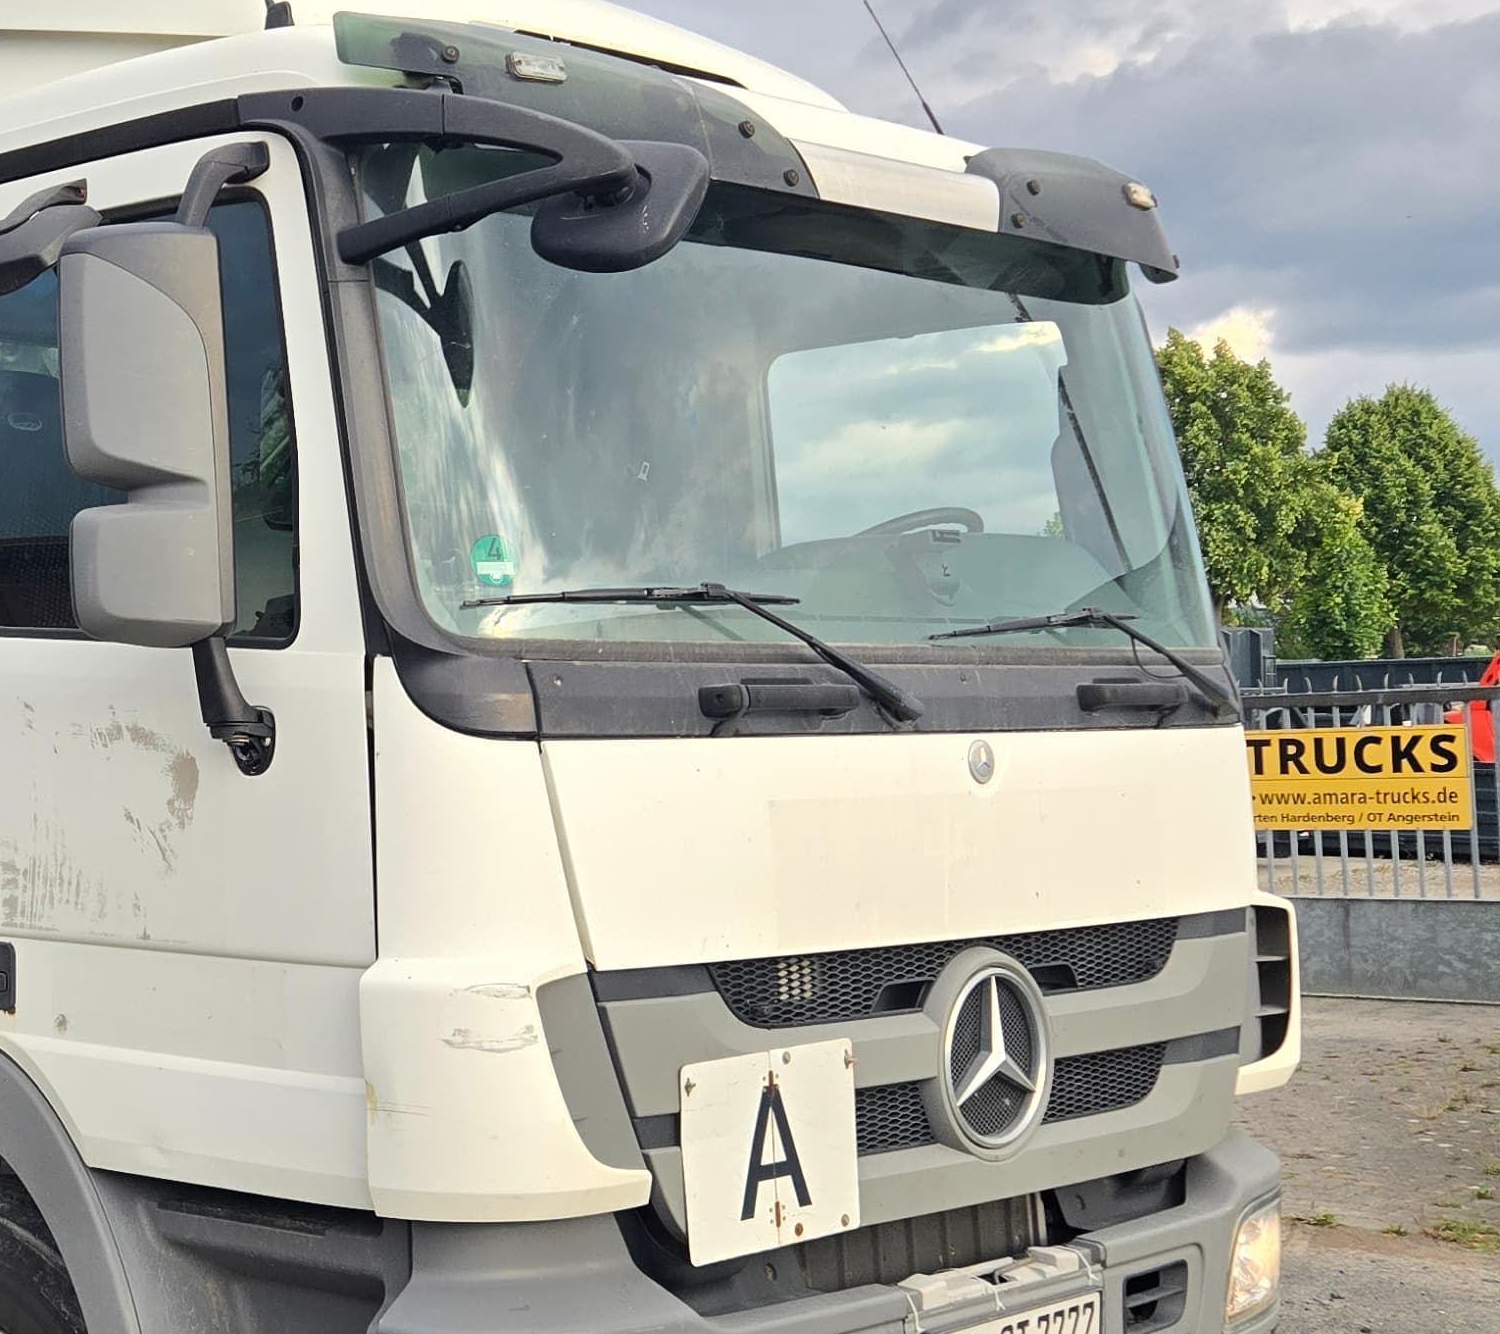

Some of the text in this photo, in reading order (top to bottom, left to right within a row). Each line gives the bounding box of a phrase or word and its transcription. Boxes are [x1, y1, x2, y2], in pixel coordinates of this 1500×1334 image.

[487, 537, 502, 561] 4
[1245, 734, 1459, 776] TRUCKS
[1259, 786, 1459, 806] www.amara-trucks.de
[1280, 812, 1356, 825] Hardenberg
[1367, 812, 1384, 822] OT
[1387, 811, 1460, 825] Angerstein
[739, 1082, 813, 1222] A
